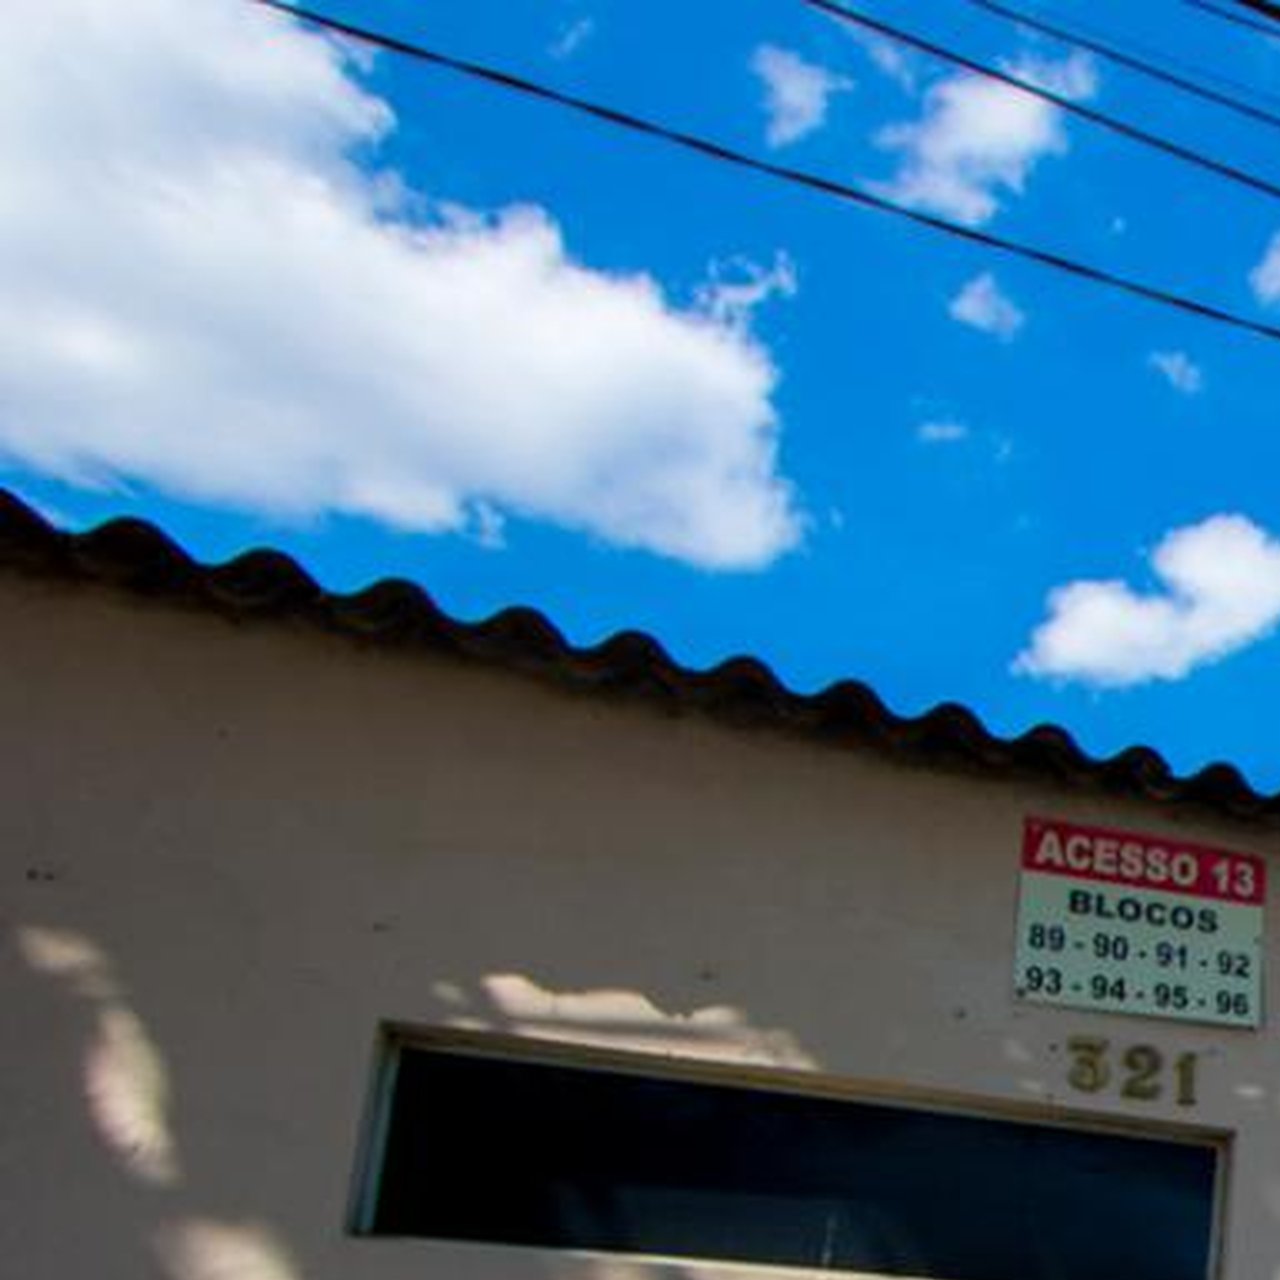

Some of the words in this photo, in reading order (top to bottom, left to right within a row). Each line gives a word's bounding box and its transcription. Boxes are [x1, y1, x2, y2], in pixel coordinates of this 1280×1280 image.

[1036, 830, 1198, 887] ACESSO
[1211, 860, 1255, 896] 13
[1069, 889, 1218, 933] BLOCOS
[1029, 924, 1065, 951] 89
[1093, 933, 1129, 961] 90
[1155, 942, 1188, 970] 91
[1217, 952, 1250, 978] 92
[1025, 966, 1062, 995] 93
[1091, 975, 1126, 1002] 94
[1154, 983, 1188, 1010] 95
[1216, 990, 1248, 1016] 96
[1066, 1034, 1198, 1107] 321
